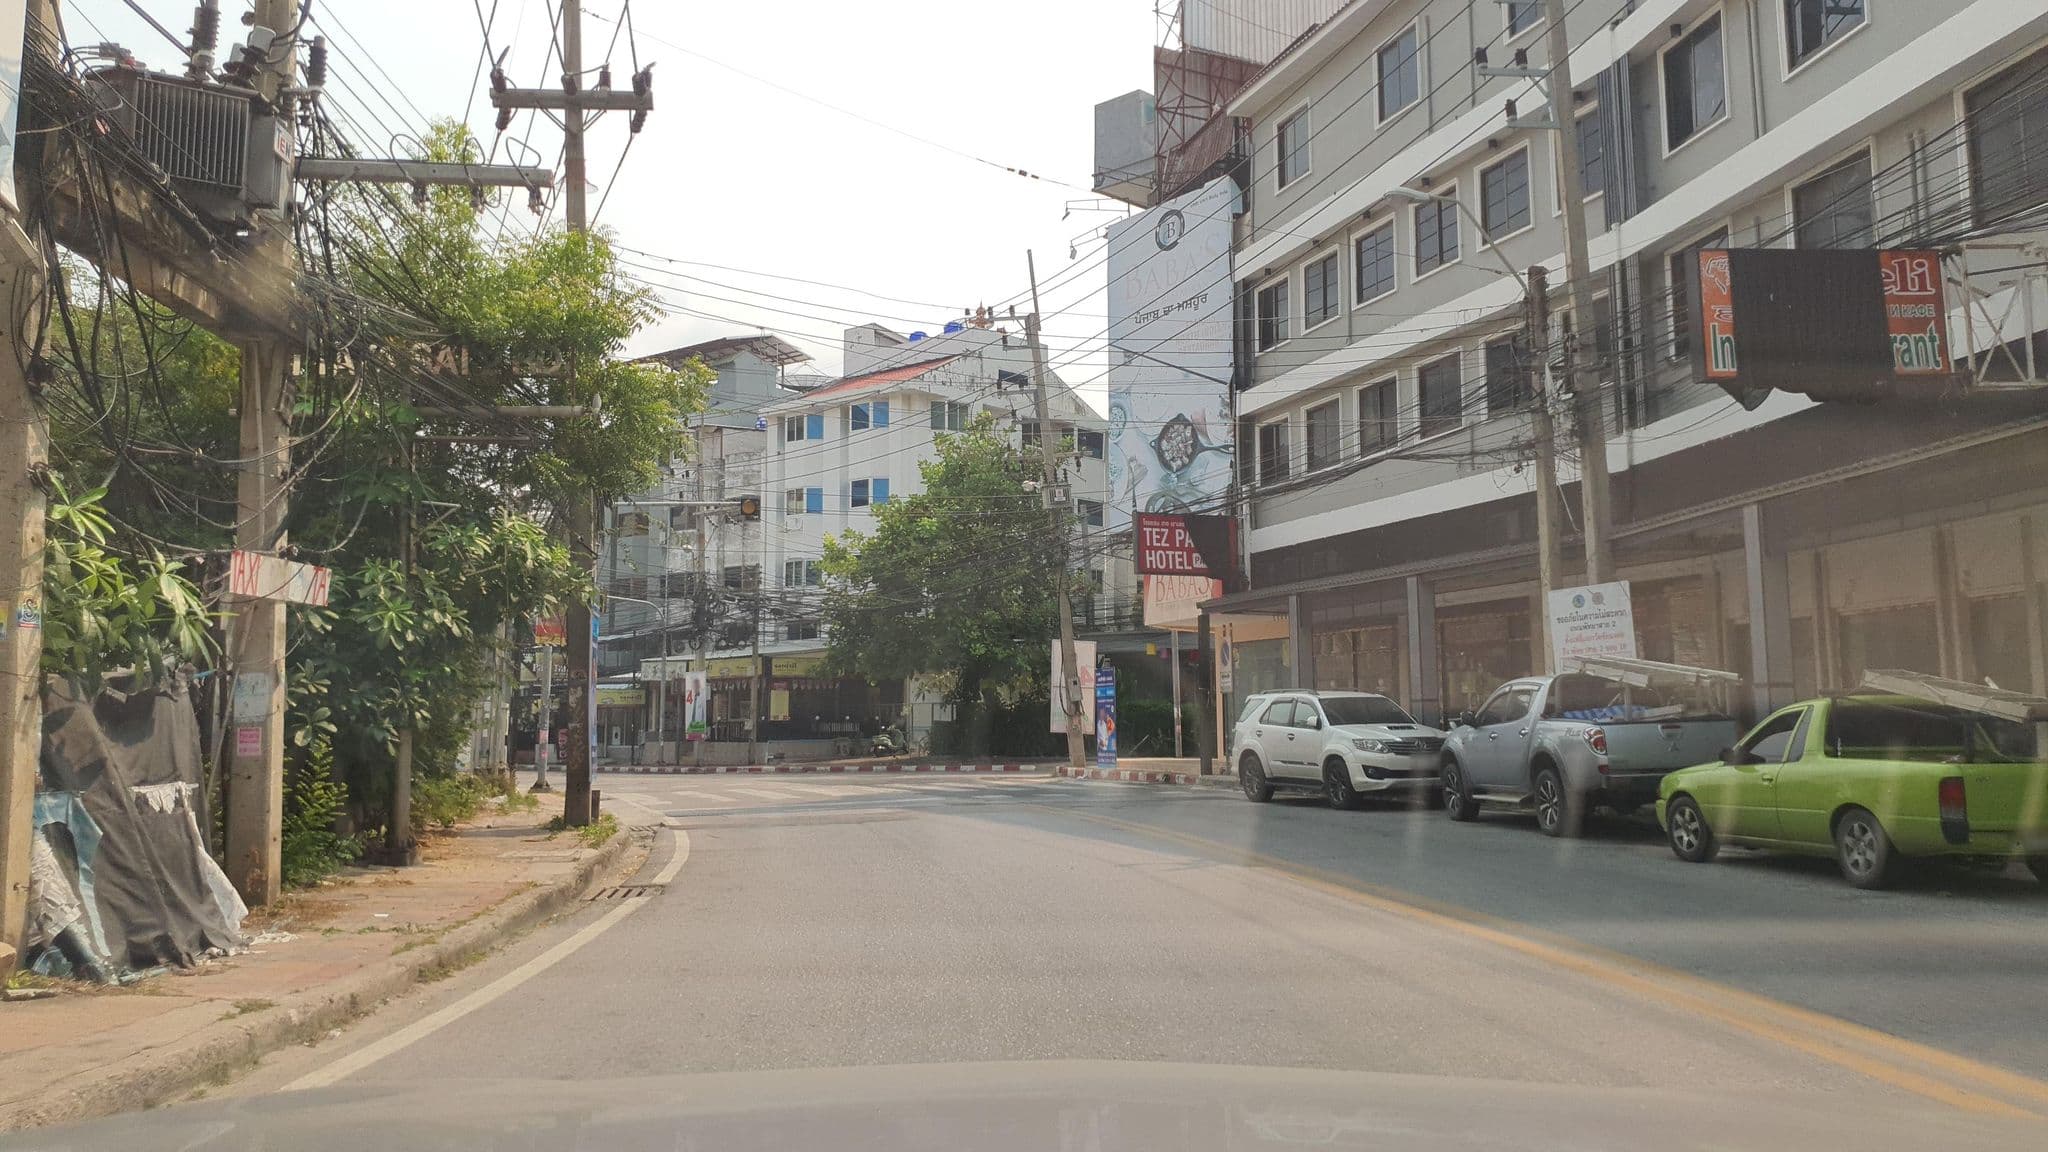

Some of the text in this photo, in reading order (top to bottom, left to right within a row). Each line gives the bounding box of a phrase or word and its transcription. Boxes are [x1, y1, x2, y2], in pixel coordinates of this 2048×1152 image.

[1903, 303, 1935, 317] КАФЕ
[1143, 527, 1169, 547] TEZ
[1145, 550, 1193, 570] HOTEL
[686, 689, 694, 705] 4
